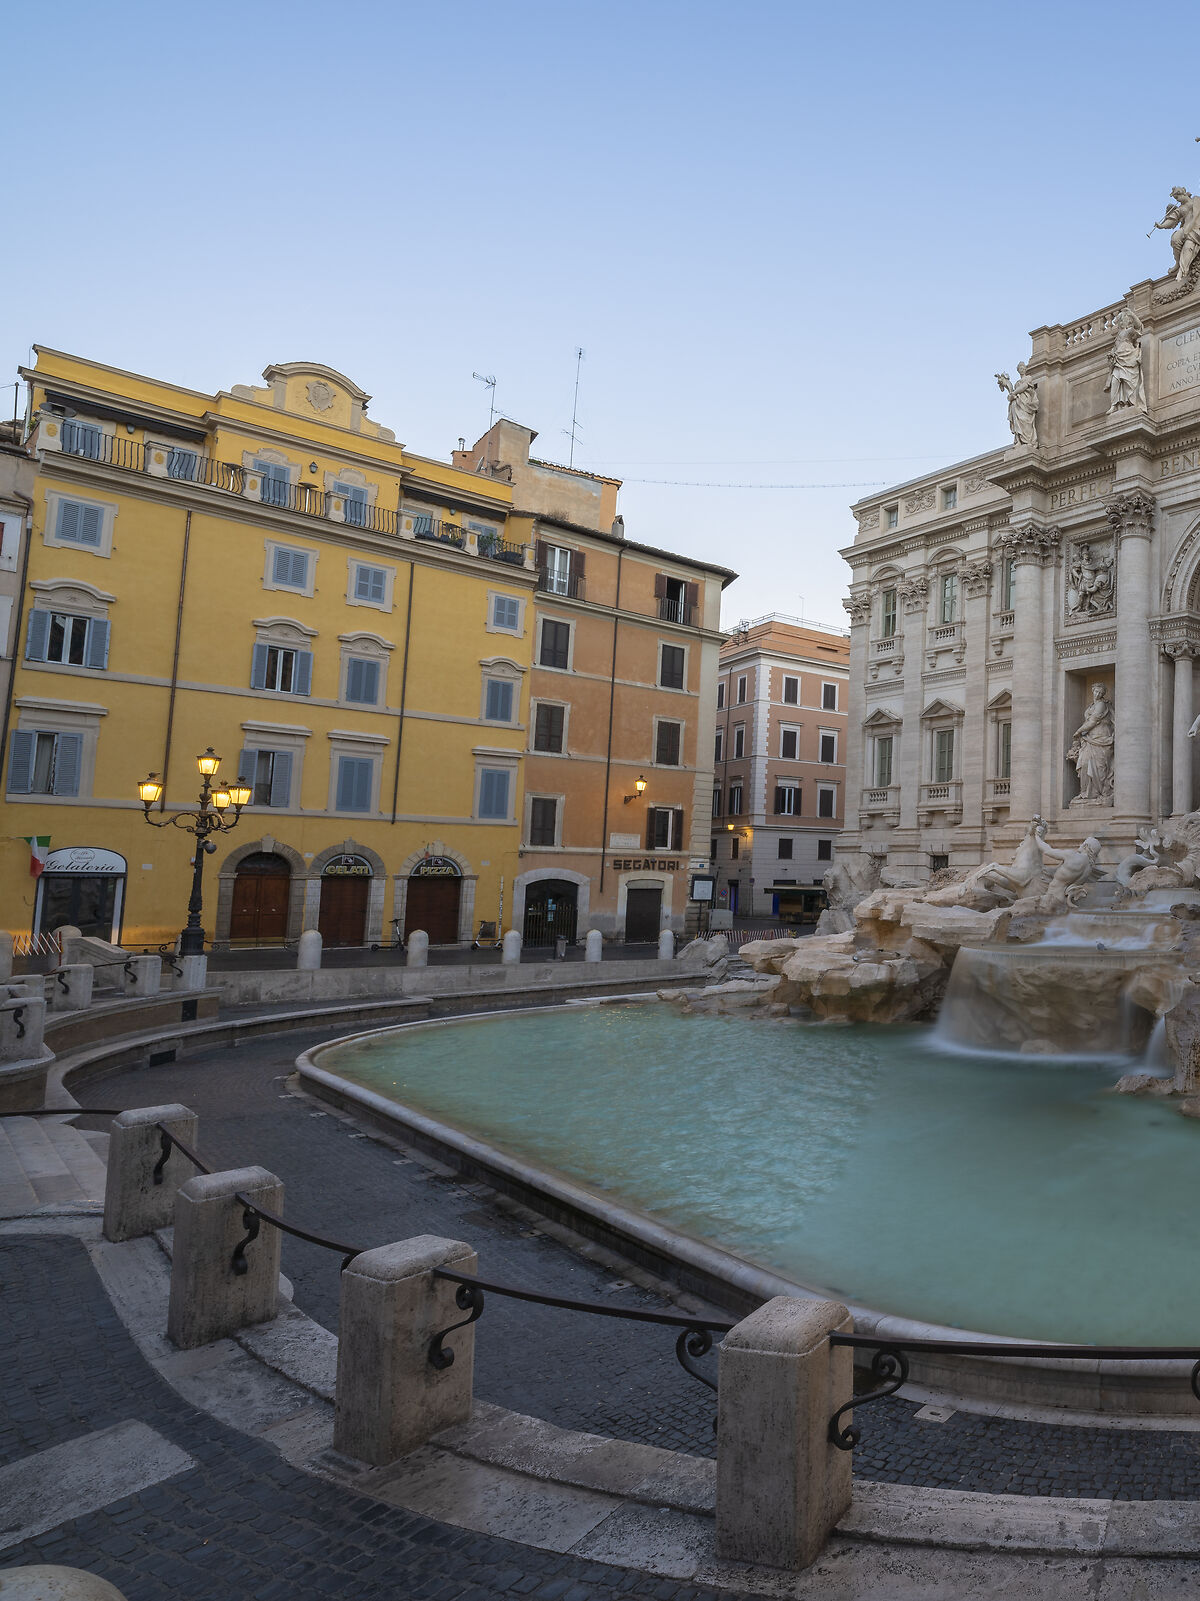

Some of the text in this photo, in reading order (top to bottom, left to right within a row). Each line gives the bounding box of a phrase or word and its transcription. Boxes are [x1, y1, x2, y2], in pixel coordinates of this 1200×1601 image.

[1170, 375, 1193, 391] ANNO
[45, 860, 117, 871] Gelateria
[325, 865, 369, 875] GELATI
[421, 866, 455, 875] PIZZA
[613, 859, 680, 871] SEGATORI
